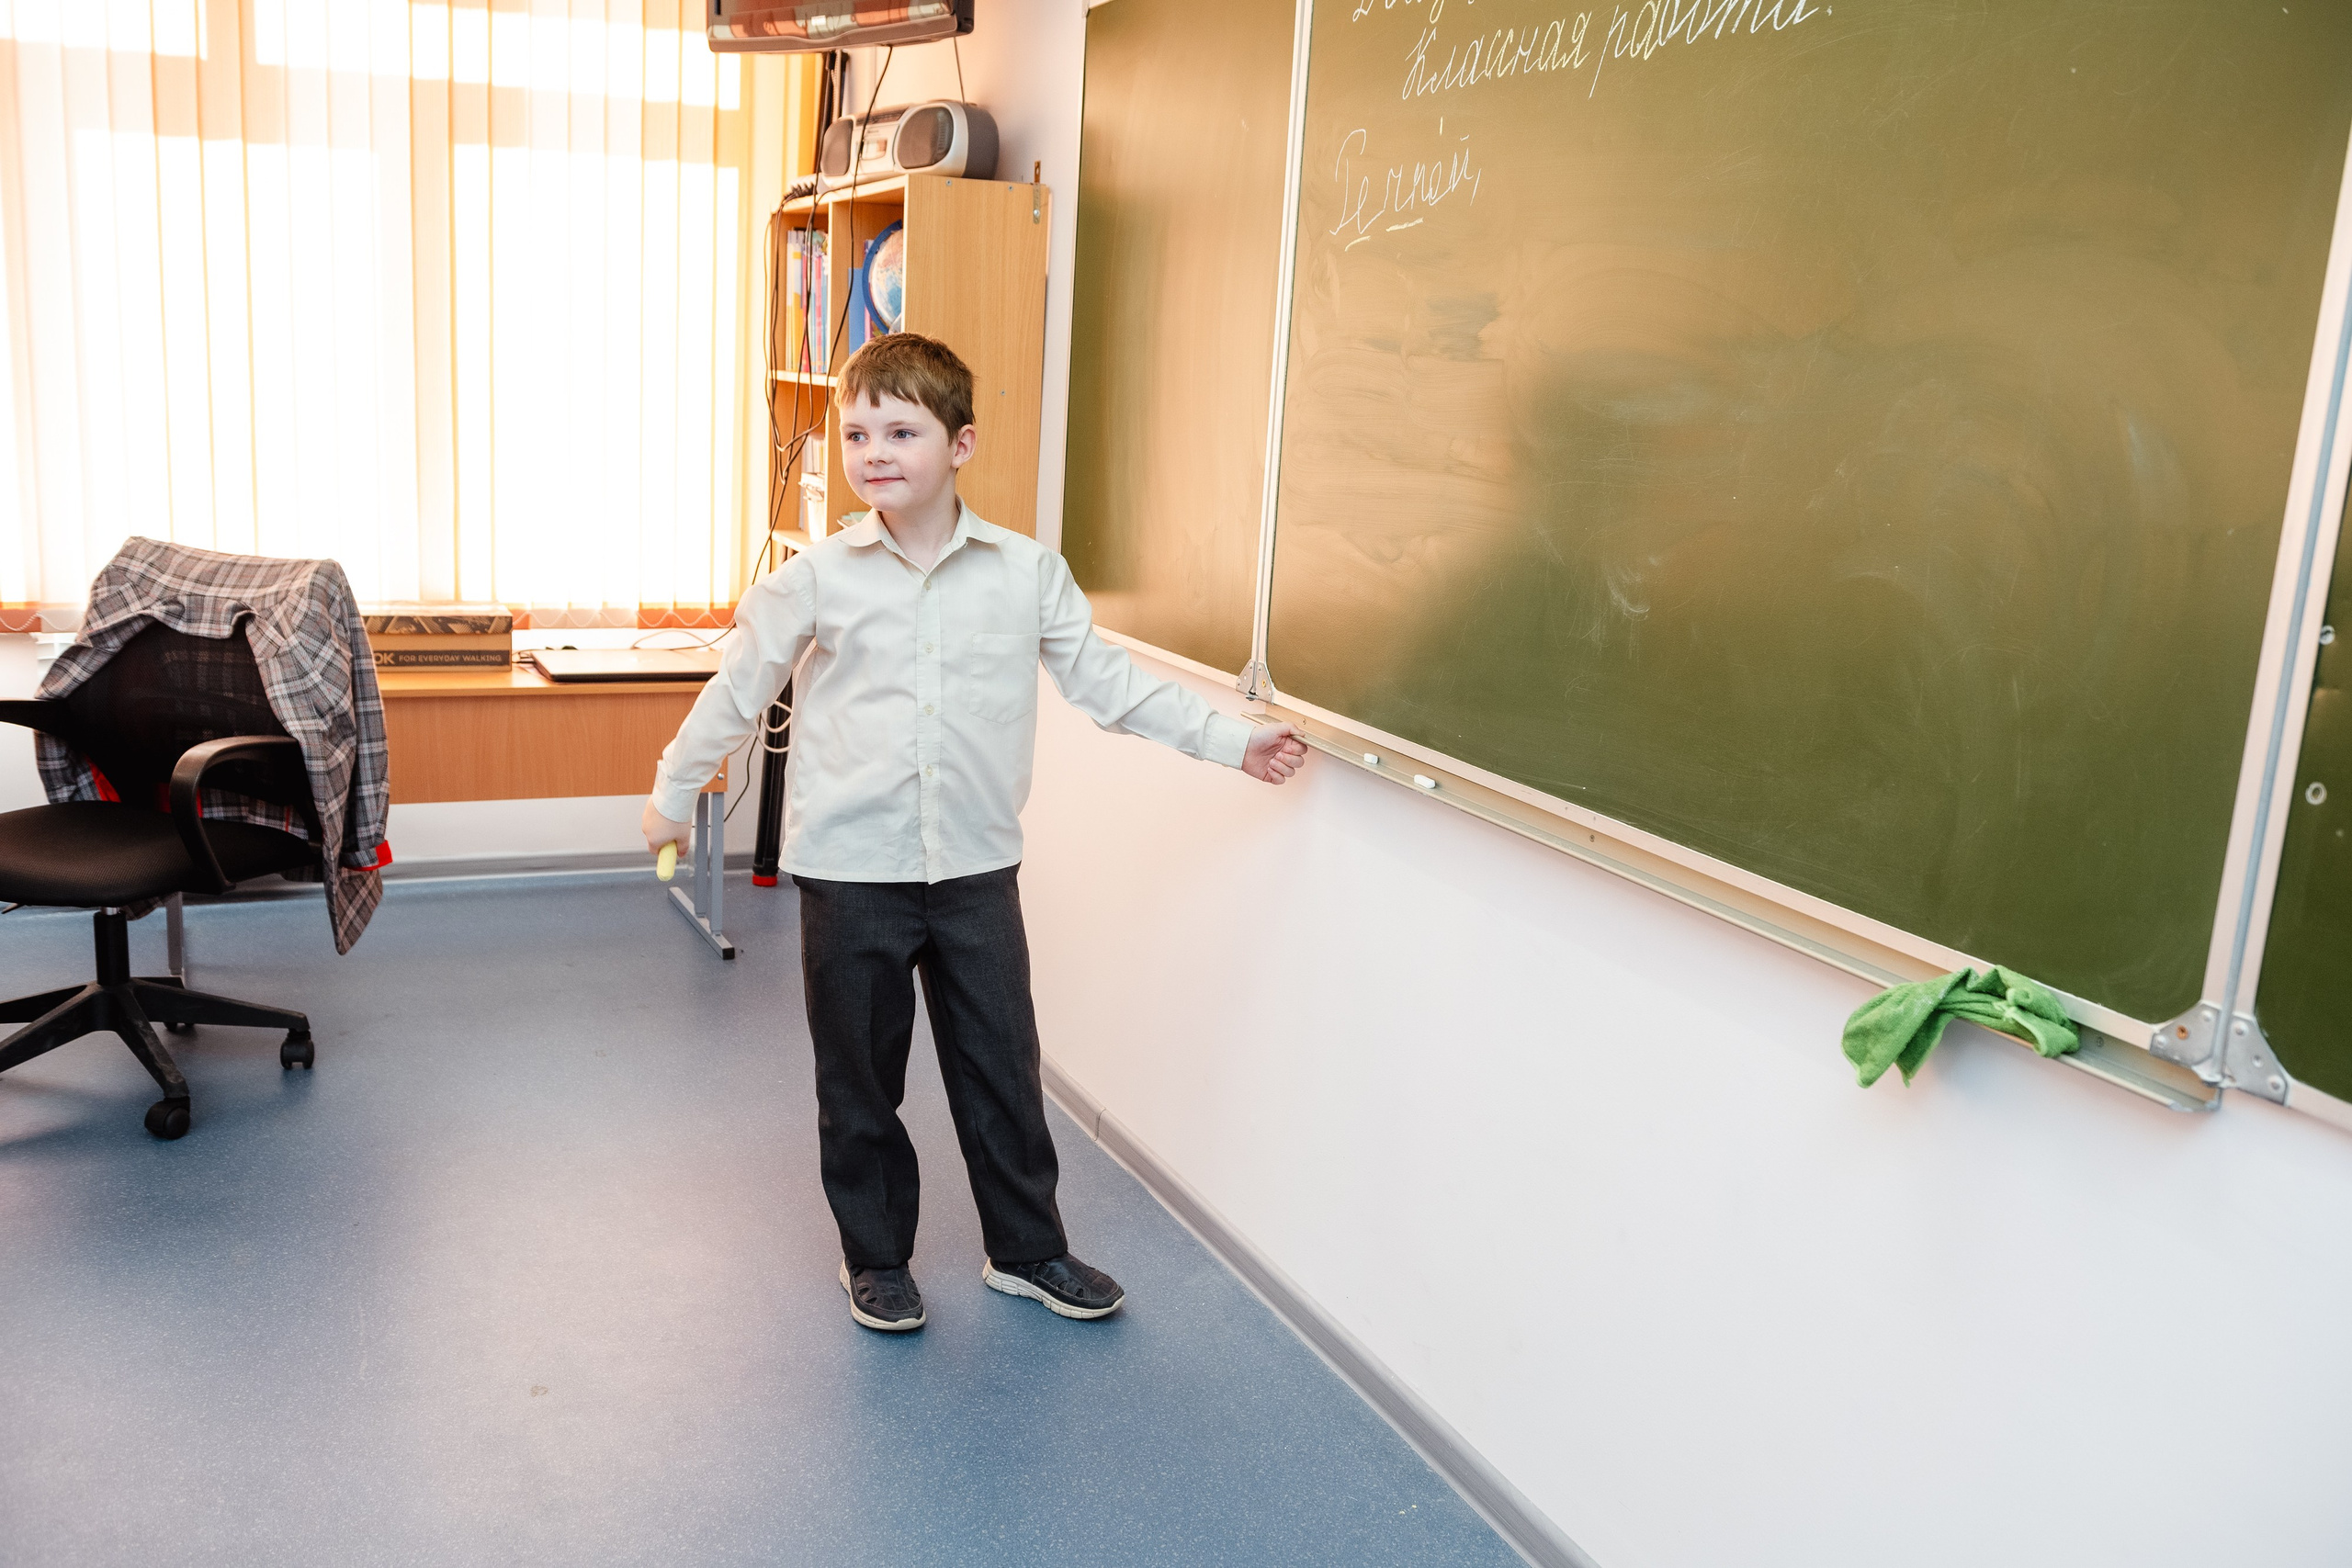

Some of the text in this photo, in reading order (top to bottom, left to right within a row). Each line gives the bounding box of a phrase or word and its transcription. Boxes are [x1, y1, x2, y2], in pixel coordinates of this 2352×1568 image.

[1402, 11, 1591, 100] Классная
[399, 654, 416, 662] FOR
[418, 654, 459, 662] EVERYDAY
[462, 654, 502, 662] WALKING
